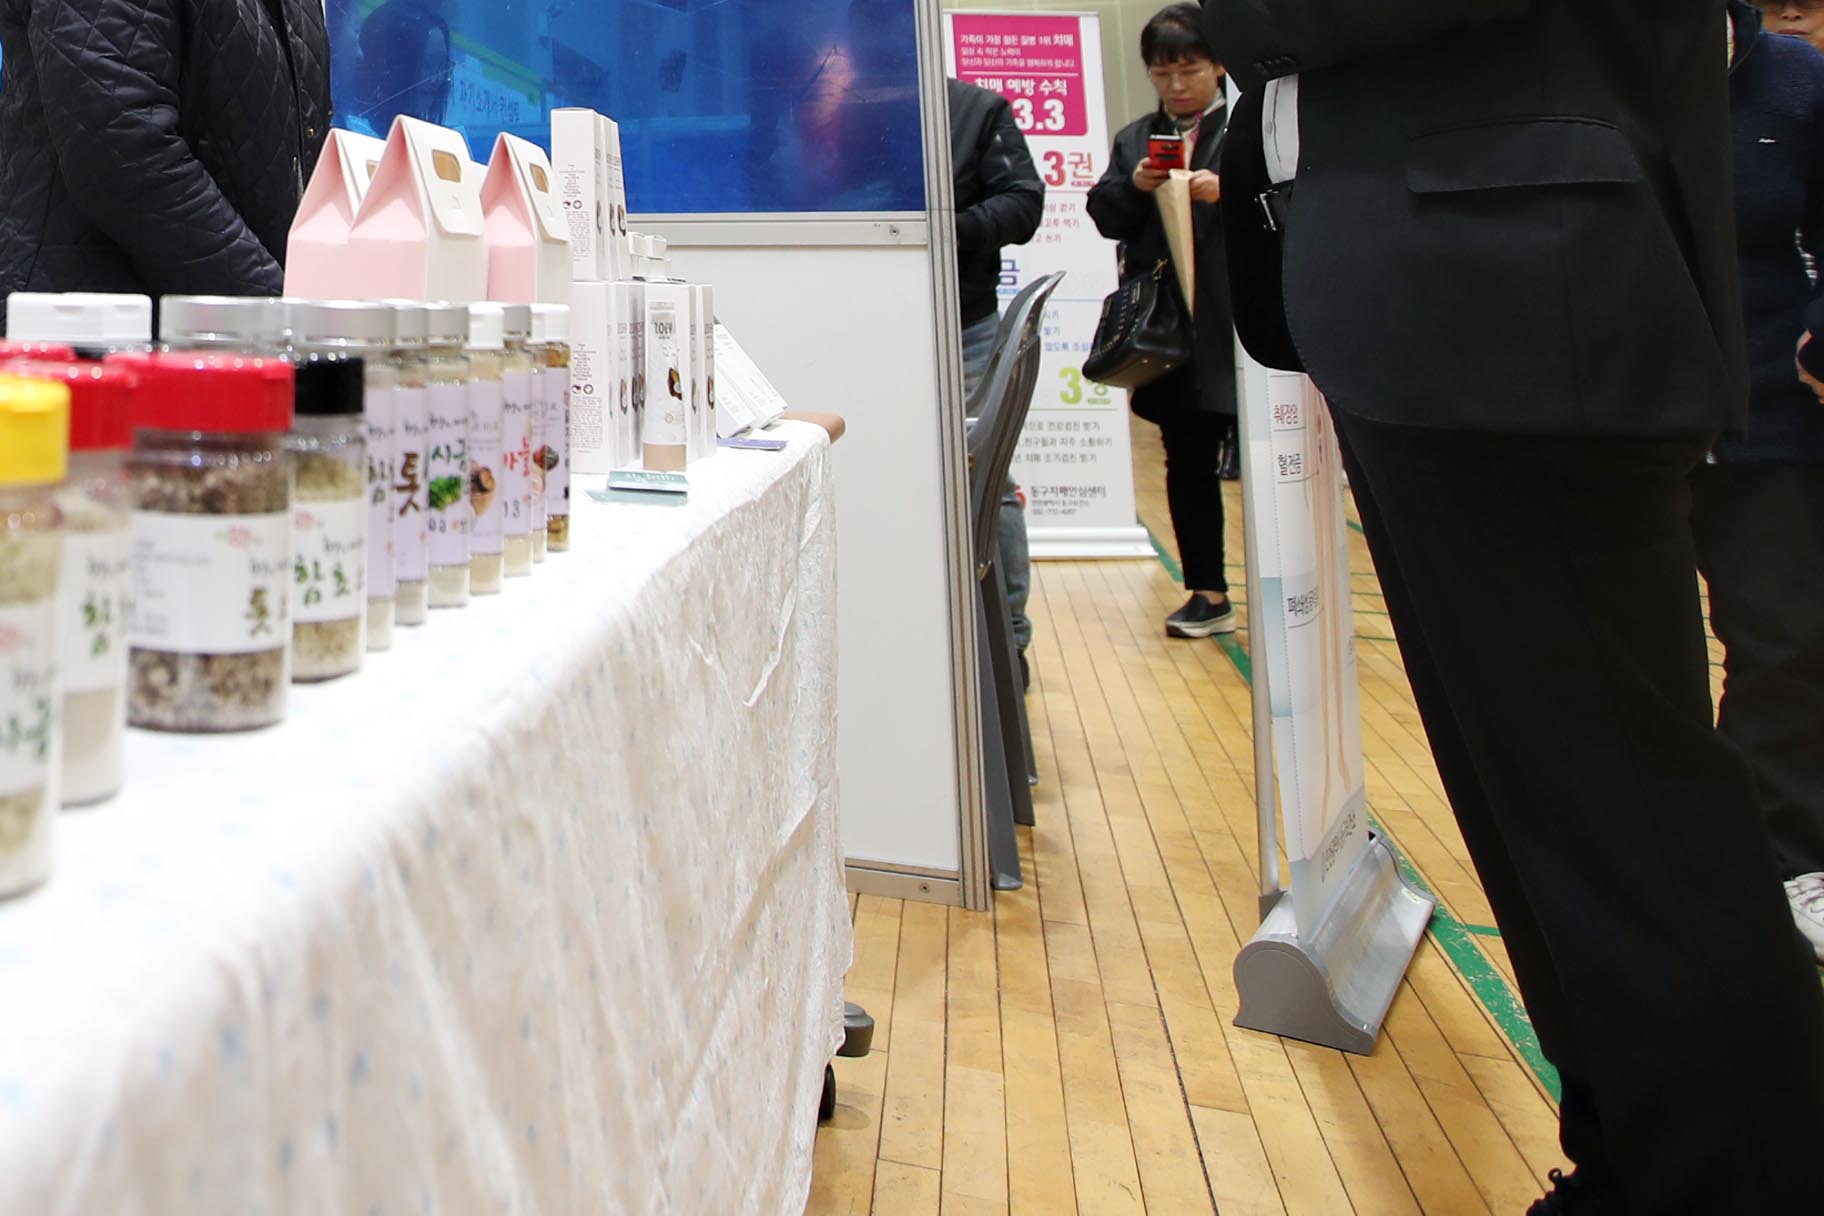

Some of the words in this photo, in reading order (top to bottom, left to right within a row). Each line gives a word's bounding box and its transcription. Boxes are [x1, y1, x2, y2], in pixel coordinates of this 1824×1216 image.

[1053, 34, 1074, 46] 치매
[975, 77, 1004, 93] 치매
[1007, 79, 1036, 96] 예방
[1039, 79, 1068, 96] 수칙
